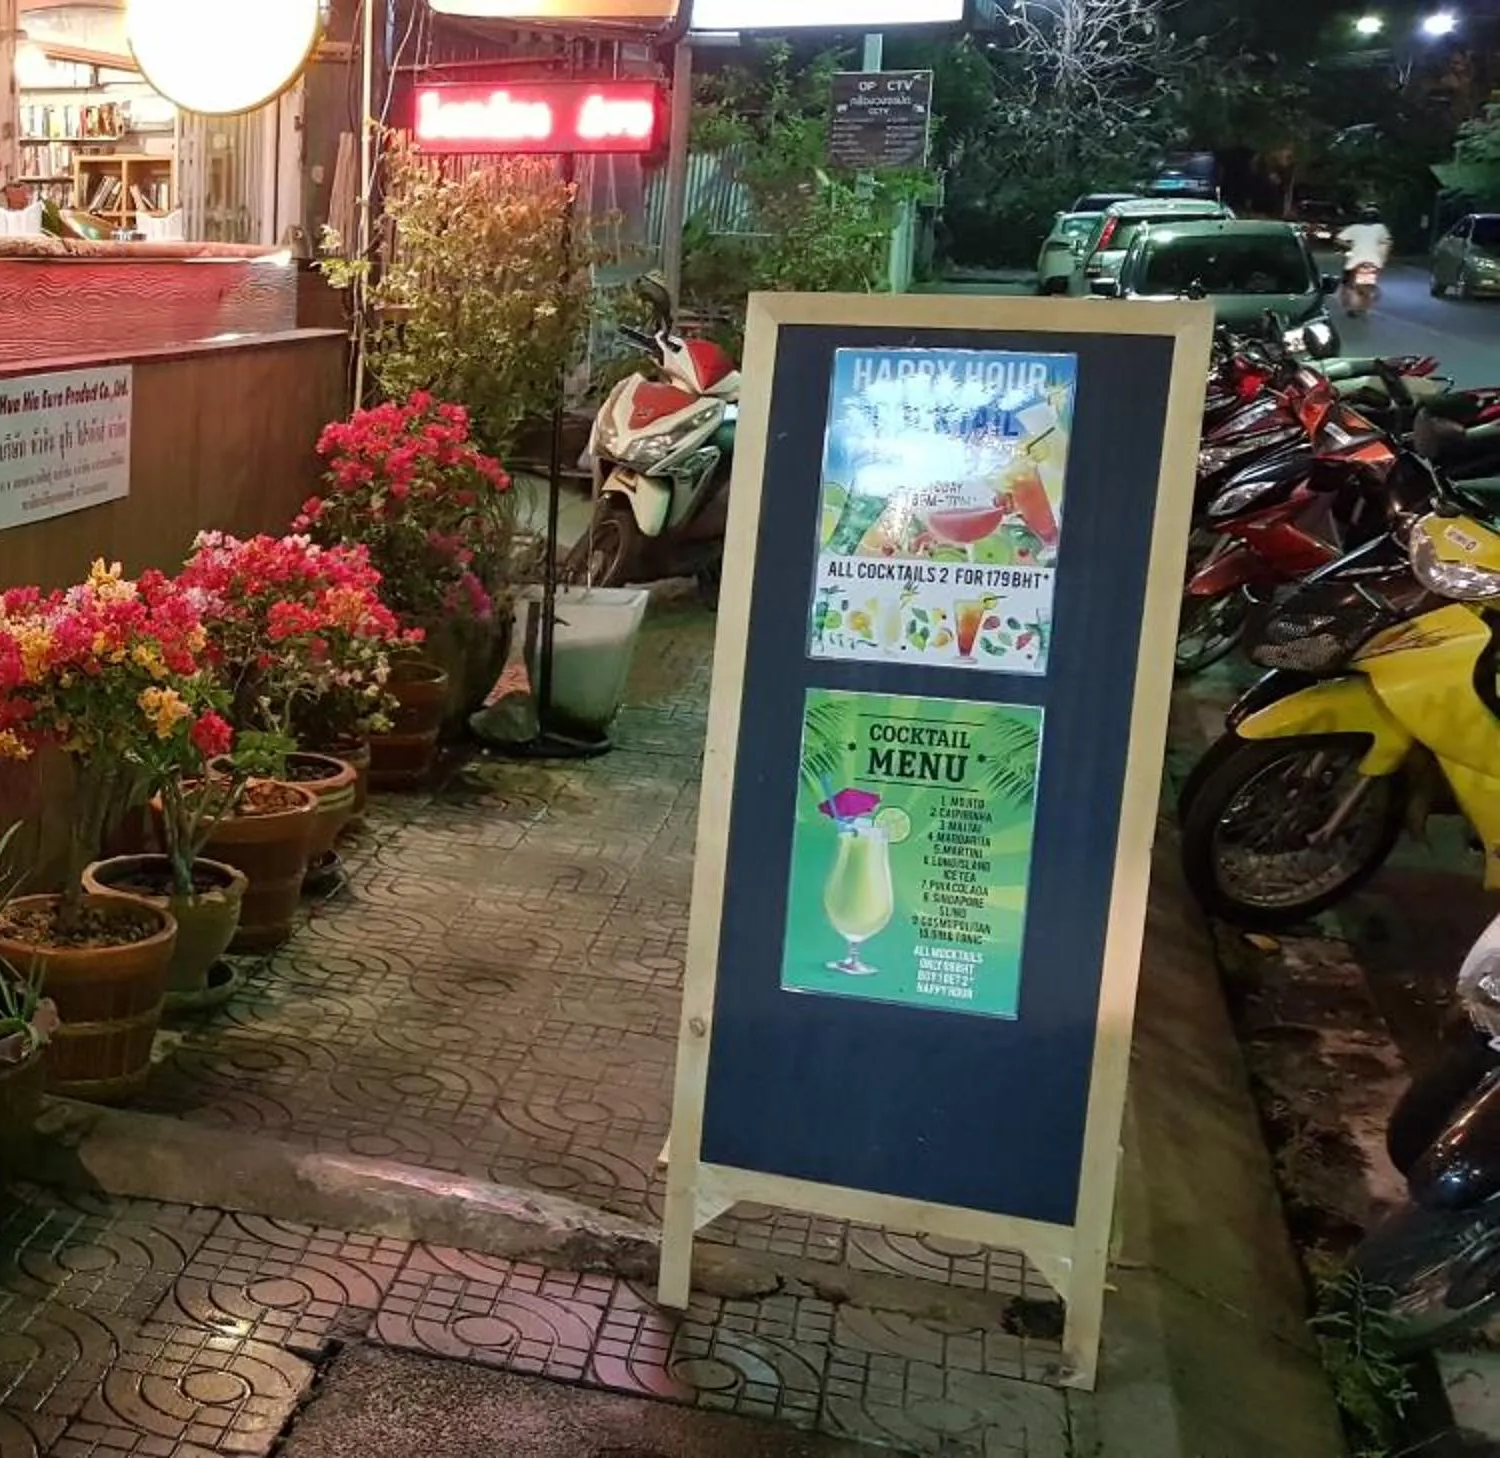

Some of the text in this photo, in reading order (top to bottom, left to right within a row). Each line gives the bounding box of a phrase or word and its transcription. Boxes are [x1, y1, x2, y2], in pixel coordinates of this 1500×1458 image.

[828, 561, 854, 578] ALL
[858, 563, 935, 583] COCKTAILS
[938, 567, 949, 584] 2
[955, 567, 985, 586] FOR
[869, 724, 971, 749] COCKTAIL
[867, 747, 969, 783] MENU
